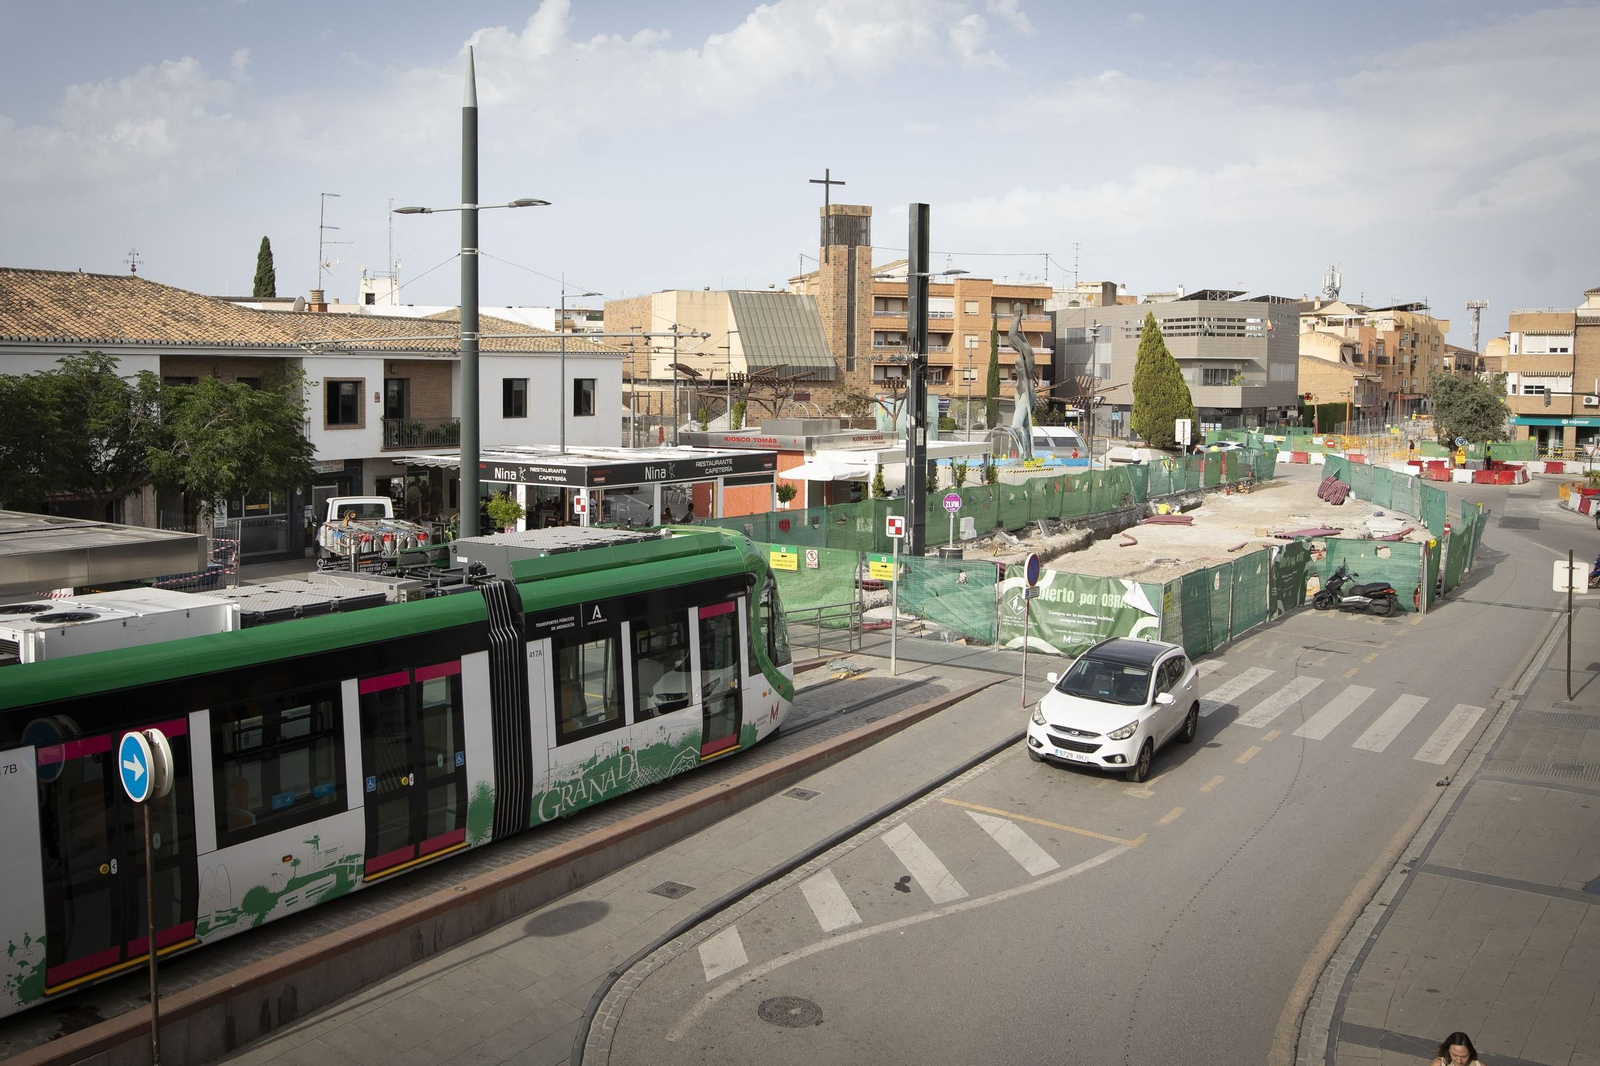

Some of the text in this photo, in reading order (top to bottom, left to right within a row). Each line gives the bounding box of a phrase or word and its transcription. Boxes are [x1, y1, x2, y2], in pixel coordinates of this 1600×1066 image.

[696, 459, 732, 467] RESTAURANTE
[494, 467, 516, 480] Nina
[645, 466, 666, 480] Nina
[705, 466, 733, 474] CAFETERÍA
[1036, 587, 1075, 603] bierto
[1080, 593, 1097, 606] por
[536, 618, 558, 628] TRANSPORTES
[556, 622, 575, 630] ANDALUCÍA
[529, 650, 542, 658] 417A
[538, 754, 640, 822] GRANADA
